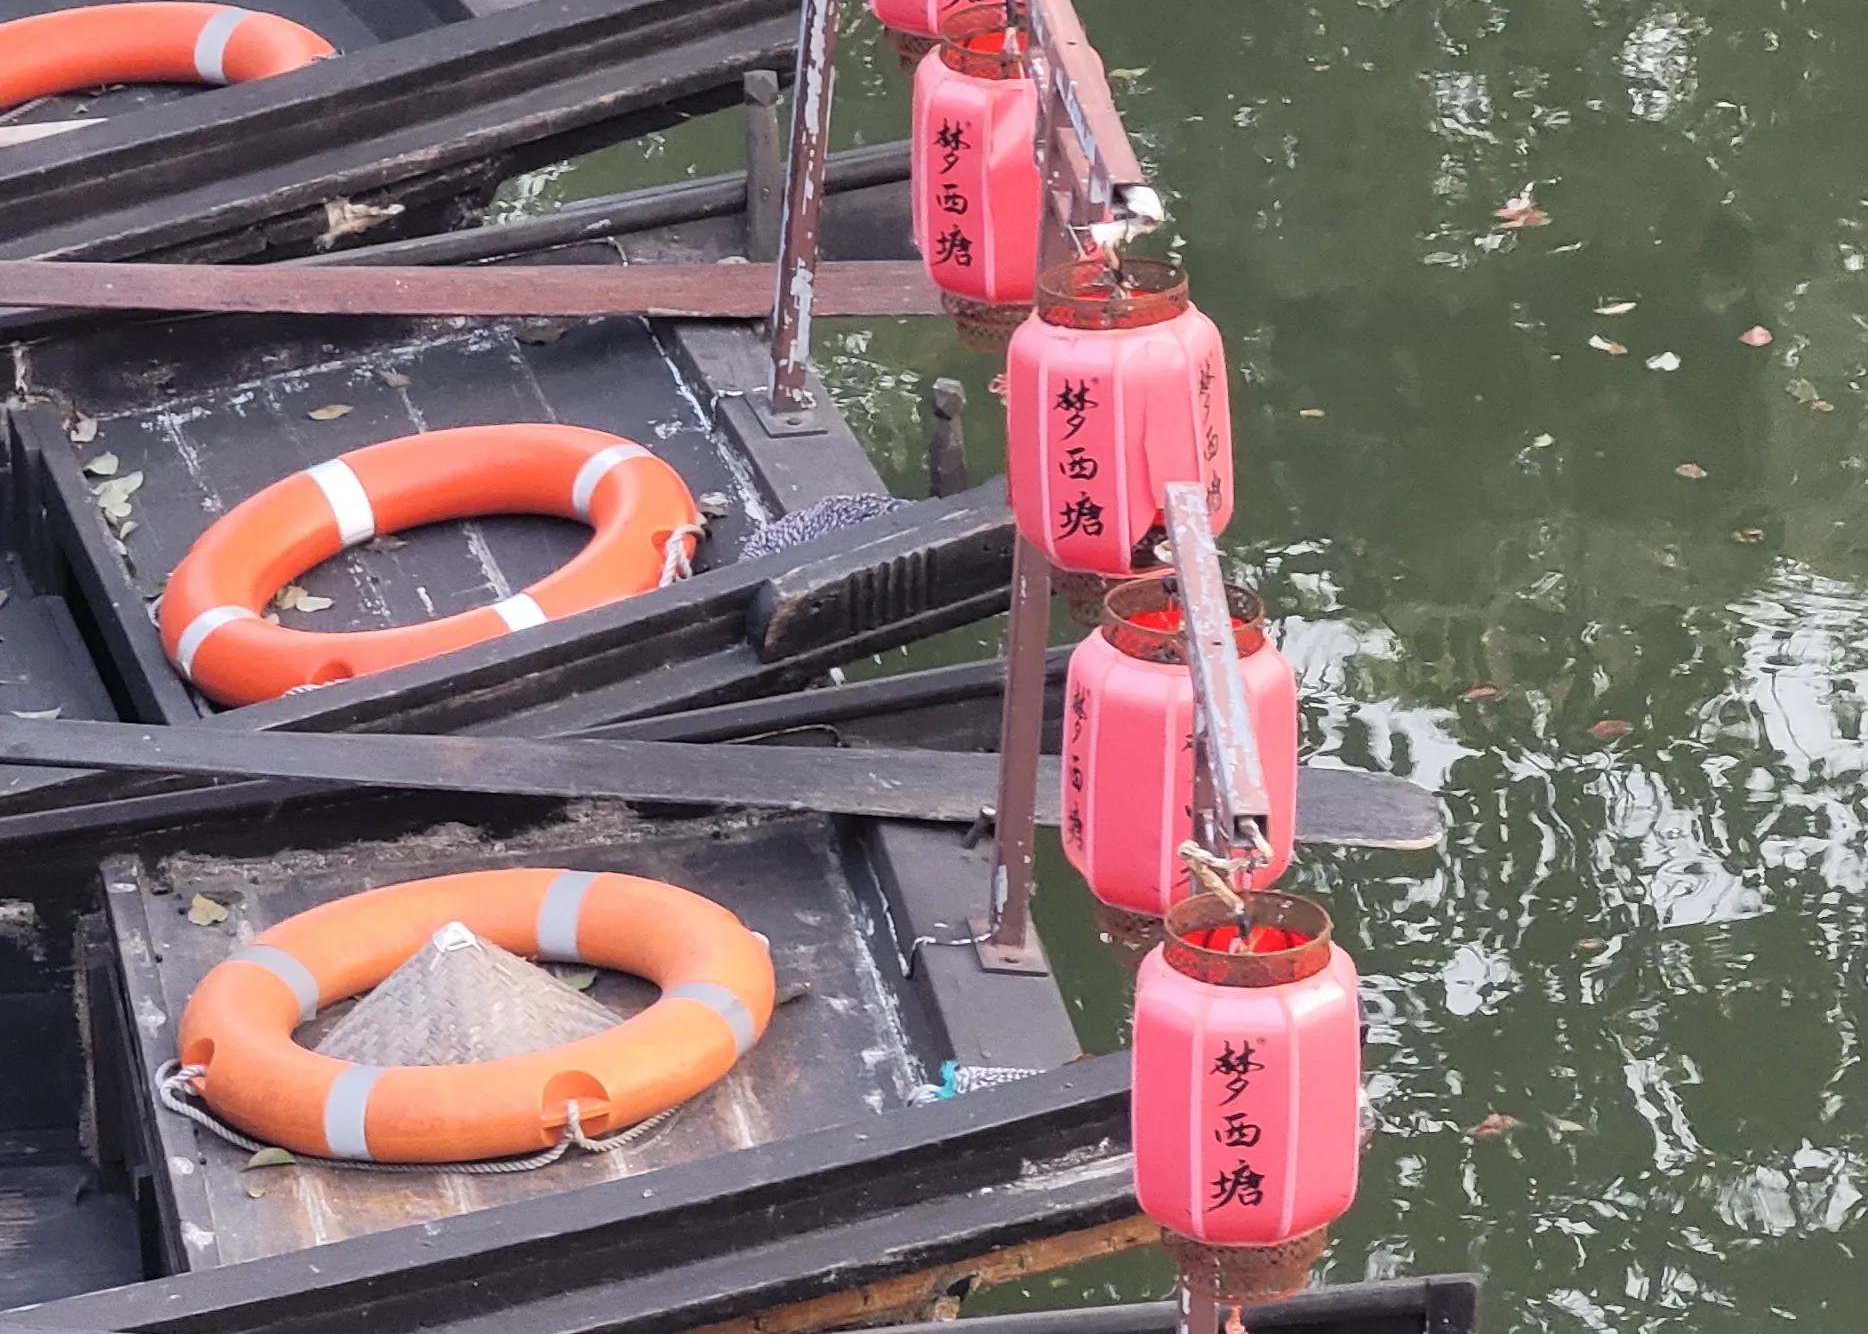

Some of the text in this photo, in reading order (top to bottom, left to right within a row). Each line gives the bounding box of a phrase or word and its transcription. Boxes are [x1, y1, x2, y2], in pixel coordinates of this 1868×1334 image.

[933, 118, 972, 268] 梦西塘
[1054, 379, 1104, 540] 梦西塘
[1210, 1041, 1265, 1212] 梦西塘
